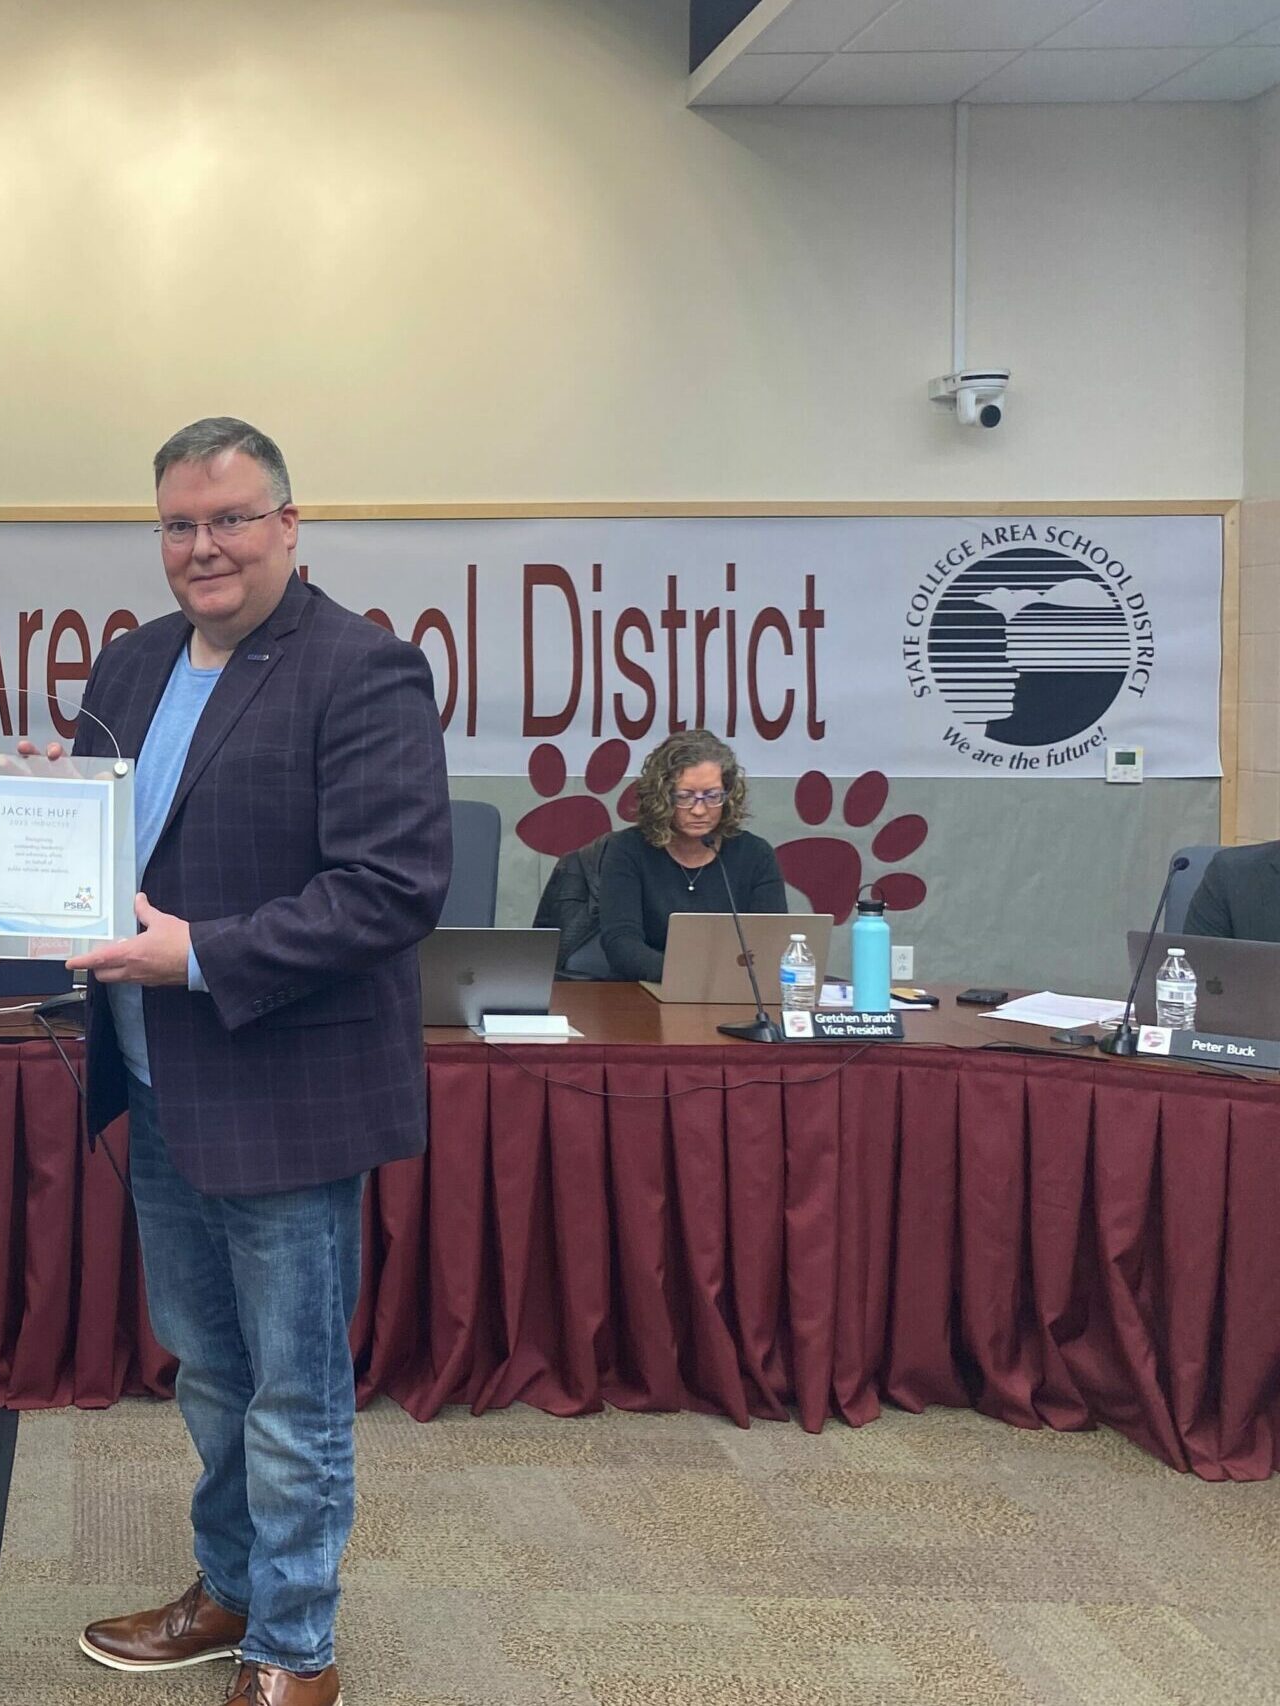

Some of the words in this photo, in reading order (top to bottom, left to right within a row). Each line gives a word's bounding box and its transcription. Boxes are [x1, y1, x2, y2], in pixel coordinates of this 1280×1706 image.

[981, 524, 1037, 550] AREA
[1045, 526, 1133, 591] SCHOOL
[906, 540, 975, 627] COLLEGE
[523, 563, 826, 740] District
[1126, 593, 1155, 698] DISTRICT
[903, 635, 931, 698] STATE
[942, 726, 970, 753] We
[972, 749, 1003, 767] are
[1009, 751, 1040, 769] the
[1047, 726, 1108, 767] future!
[1, 806, 44, 817] JACKIE
[47, 808, 79, 818] HUFF
[64, 902, 92, 911] PSBA
[815, 1013, 860, 1023] Gretchen
[862, 1013, 896, 1023] Brandt
[822, 1025, 844, 1035] Vice
[846, 1025, 893, 1035] President
[1192, 1040, 1224, 1053] Peter
[1227, 1044, 1256, 1057] Buck
